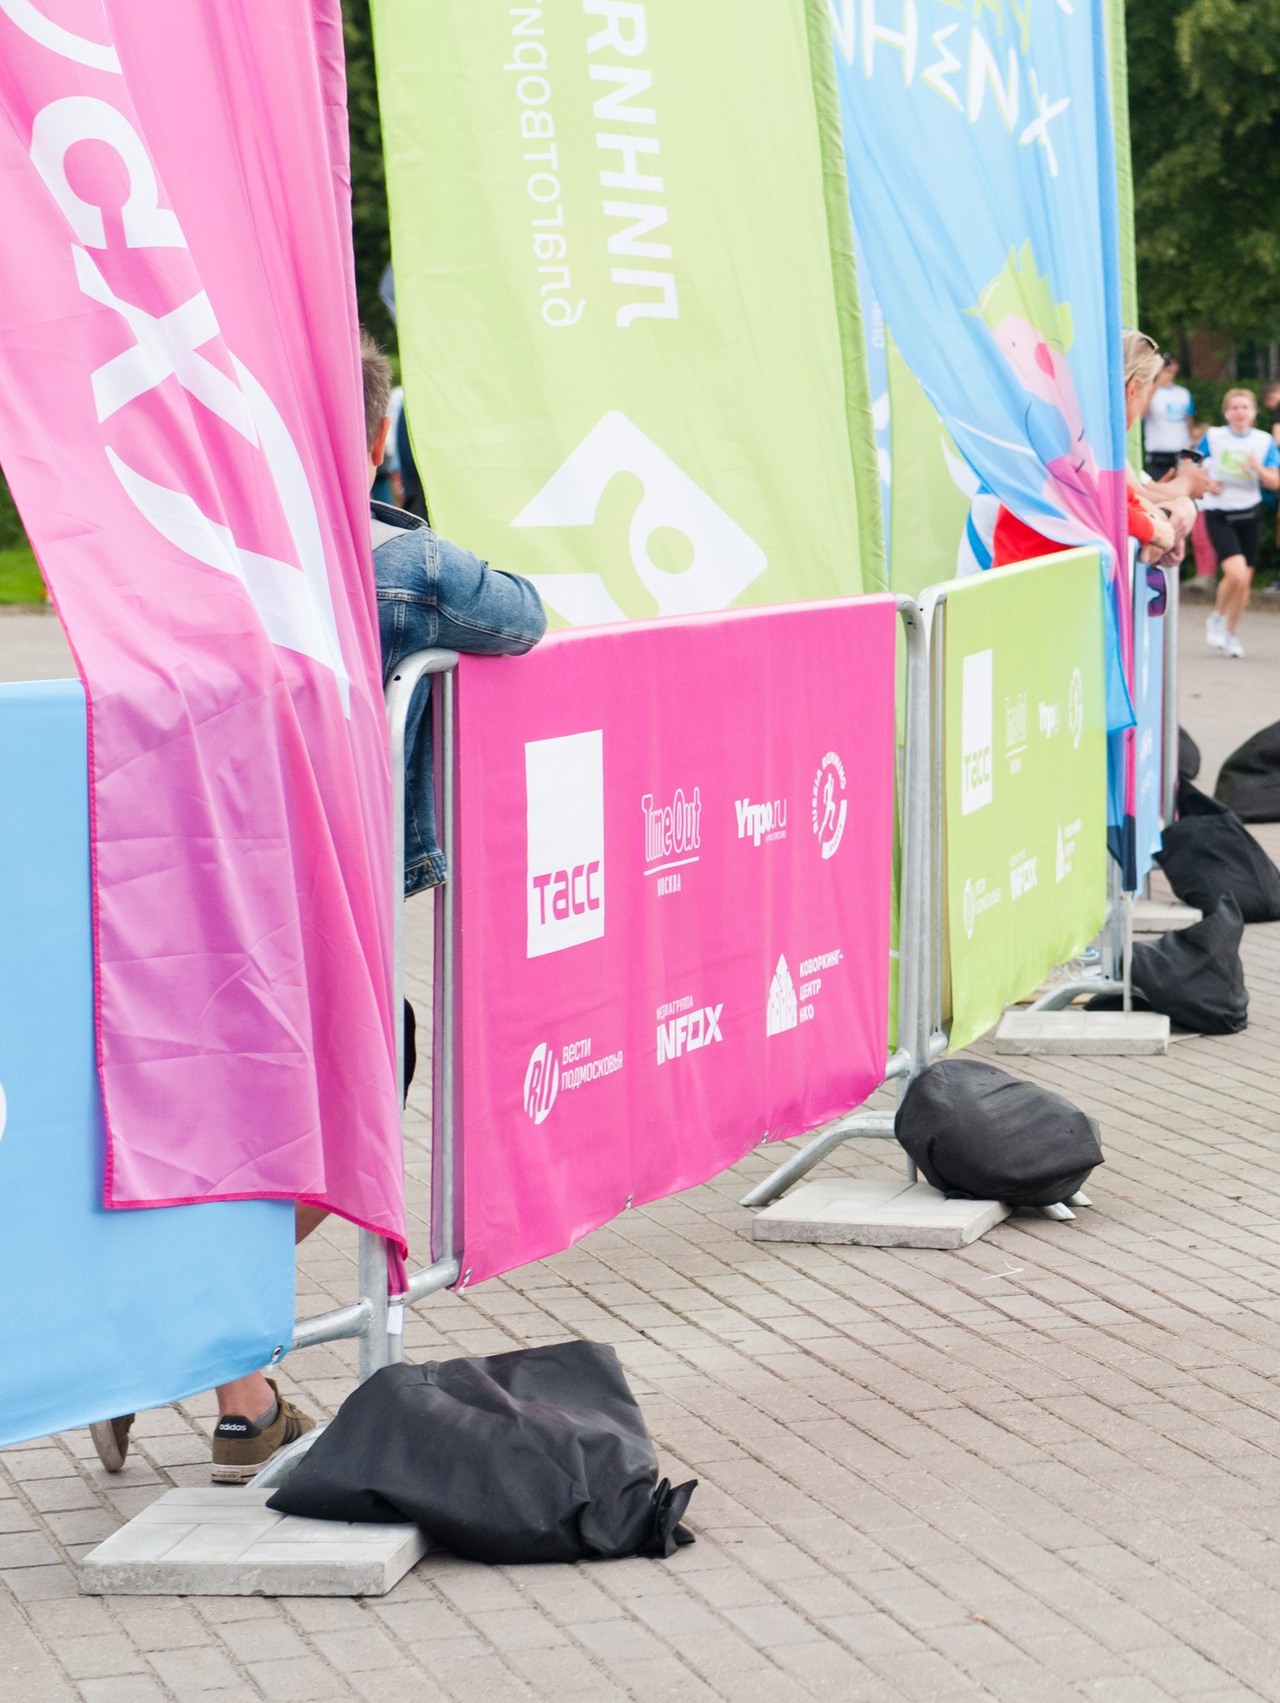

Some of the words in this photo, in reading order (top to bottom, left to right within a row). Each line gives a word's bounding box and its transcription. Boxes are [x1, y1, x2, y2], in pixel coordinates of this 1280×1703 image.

[656, 1003, 724, 1066] INFOX
[561, 1050, 623, 1091] ПОДМОСКОВЬЯ
[219, 1423, 247, 1431] adidas
